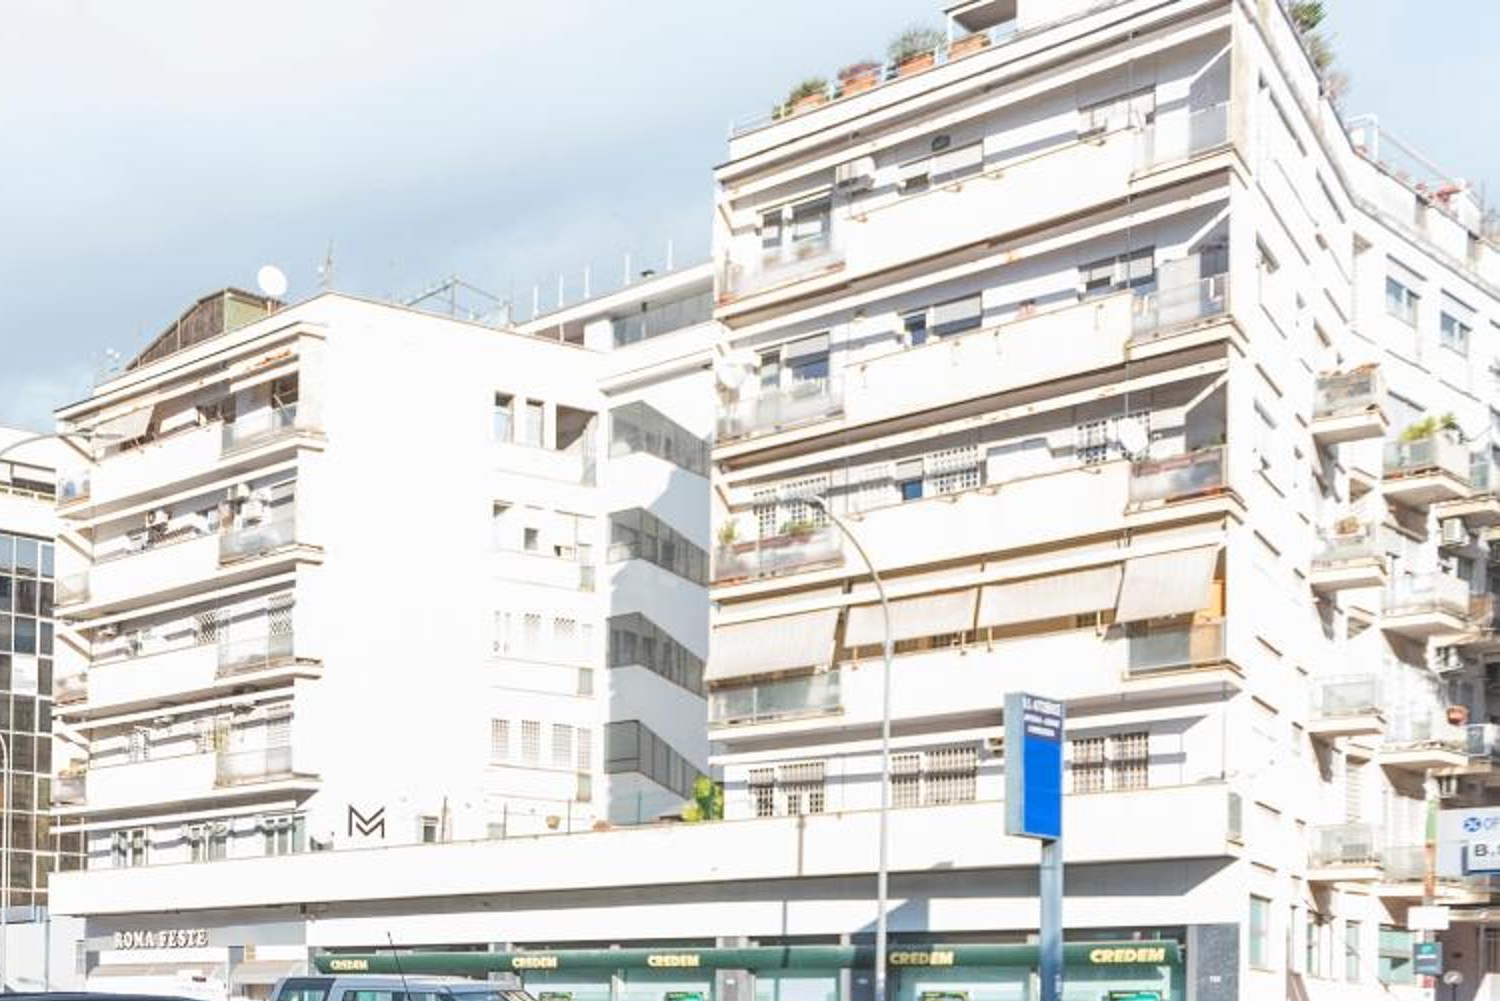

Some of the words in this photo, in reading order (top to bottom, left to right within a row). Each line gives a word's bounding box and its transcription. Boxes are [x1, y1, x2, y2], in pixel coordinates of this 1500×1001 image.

[114, 930, 155, 950] ROMA
[158, 927, 209, 948] FESTE
[647, 954, 701, 967] CREDEM
[889, 951, 955, 965] CREDEM
[1089, 947, 1166, 963] CREDEM
